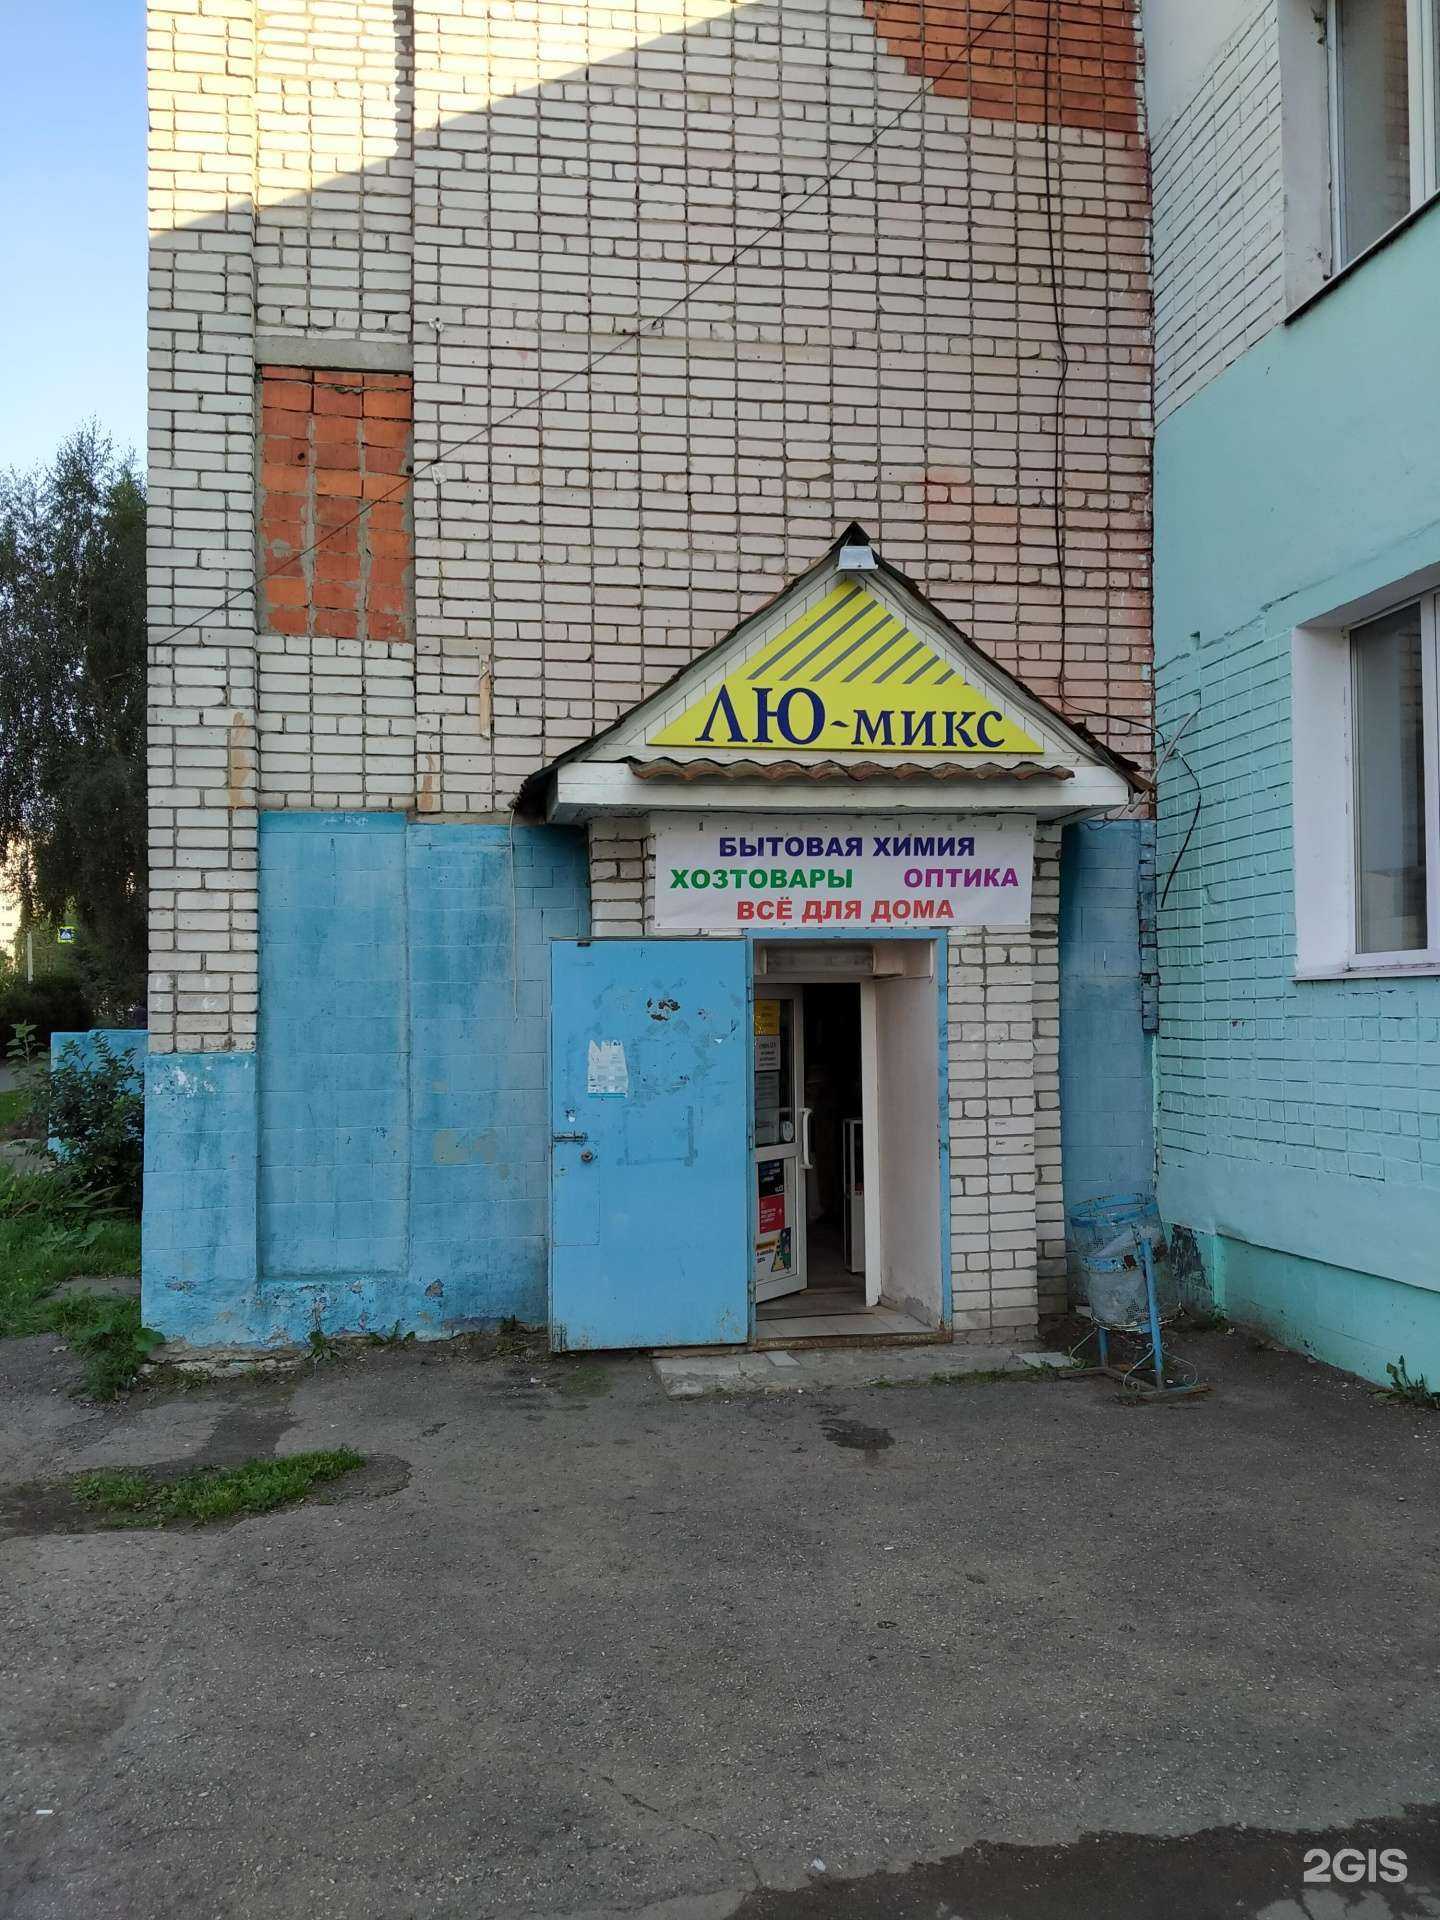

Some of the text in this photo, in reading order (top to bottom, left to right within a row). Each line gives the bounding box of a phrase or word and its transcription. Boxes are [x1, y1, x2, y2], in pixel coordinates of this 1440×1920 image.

[719, 837, 975, 858] БЫТОВАЯ ХИМИЯ
[670, 868, 854, 890] ХОЗТОВАРЫ
[903, 868, 1019, 888] ОПТИКА
[737, 897, 954, 924] ВСЁ ДЛЯ ДОМА
